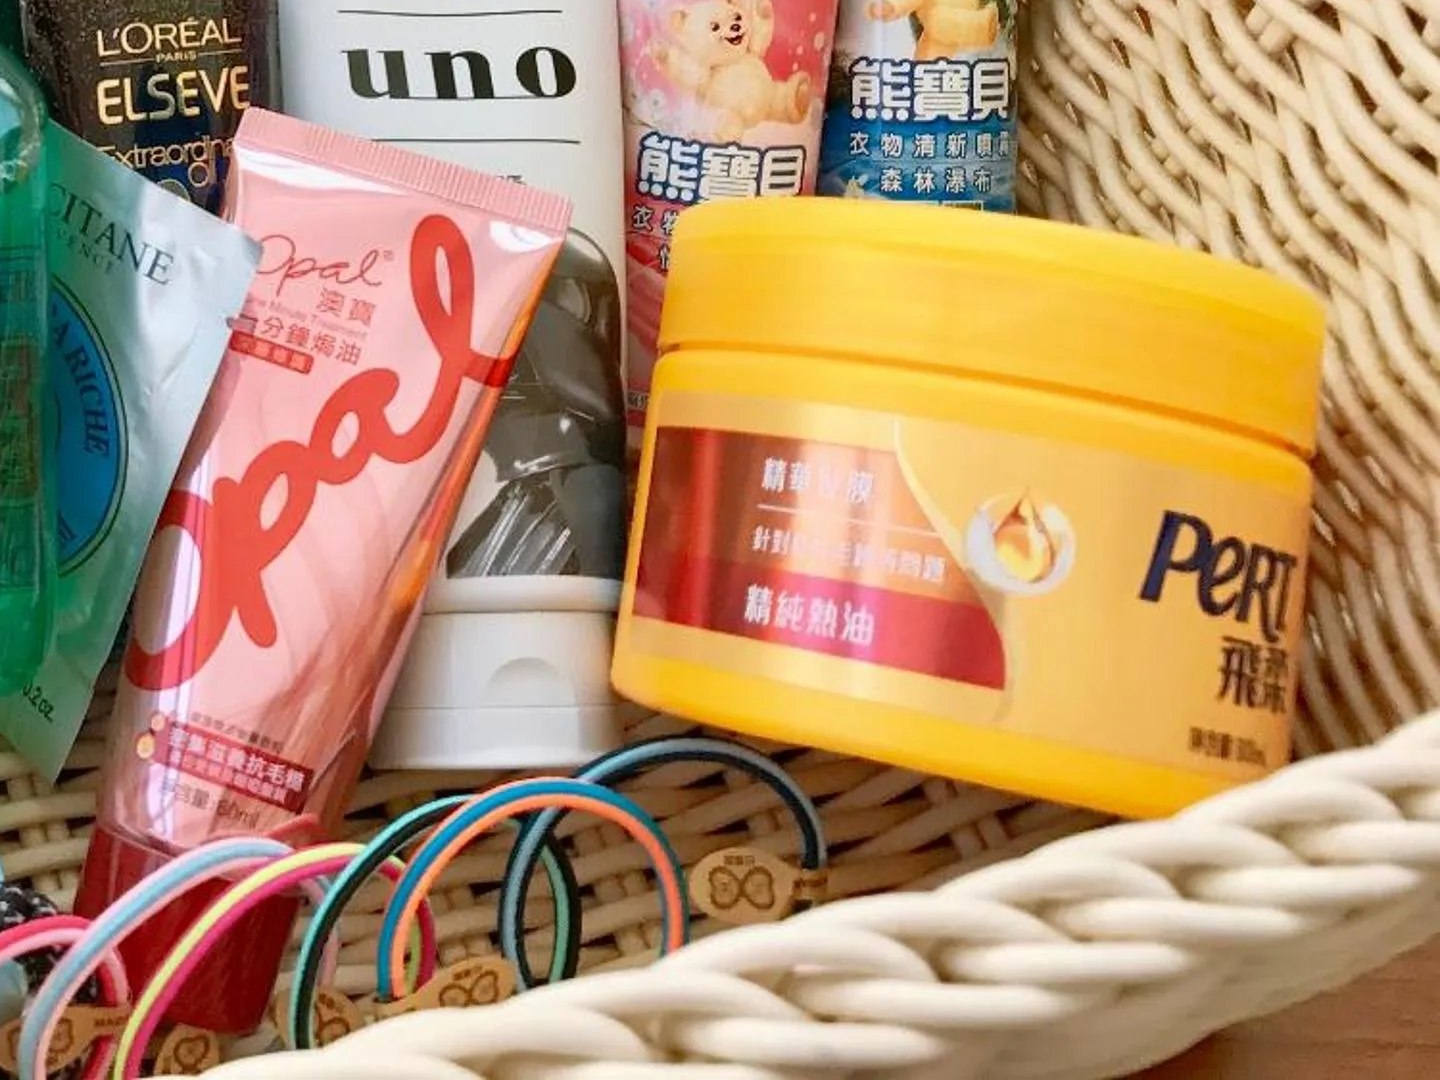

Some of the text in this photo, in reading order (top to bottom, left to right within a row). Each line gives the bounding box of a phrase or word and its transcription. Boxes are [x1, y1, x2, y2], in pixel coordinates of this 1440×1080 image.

[97, 16, 243, 58] L'ORÉAL
[96, 65, 251, 126] ELSEVE
[340, 46, 577, 100] uno
[848, 55, 1012, 123] 熊寶貝
[95, 135, 234, 170] xtraordina
[635, 130, 807, 201] 熊寶貝
[879, 166, 993, 194] 森林瀑布
[49, 182, 174, 286] CITANE
[256, 233, 383, 298] Opal
[743, 581, 876, 647] 精純熱油
[1216, 634, 1289, 715] 飛柔
